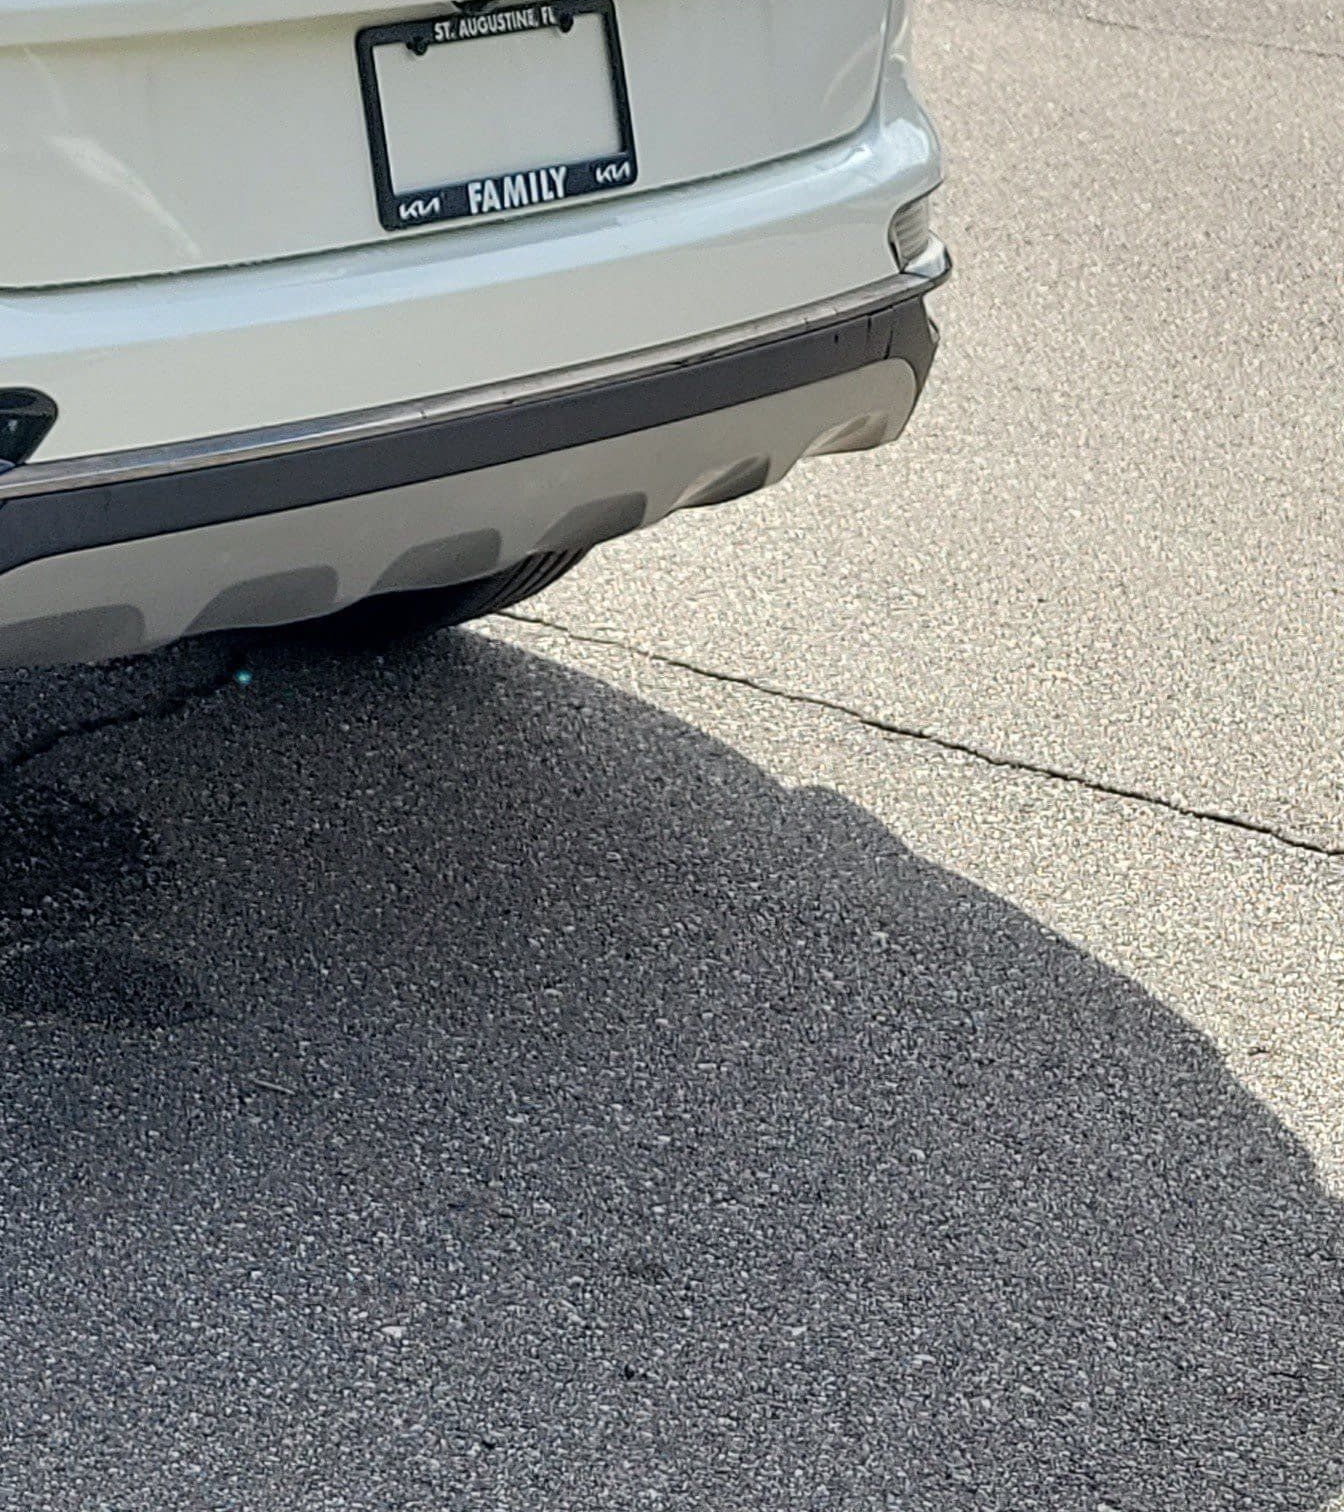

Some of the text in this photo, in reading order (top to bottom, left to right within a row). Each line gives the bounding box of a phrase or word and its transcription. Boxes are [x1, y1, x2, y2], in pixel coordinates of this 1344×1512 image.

[434, 21, 456, 41] ST.
[541, 6, 557, 25] FL
[399, 161, 631, 220] KIA FAMILY KIA
